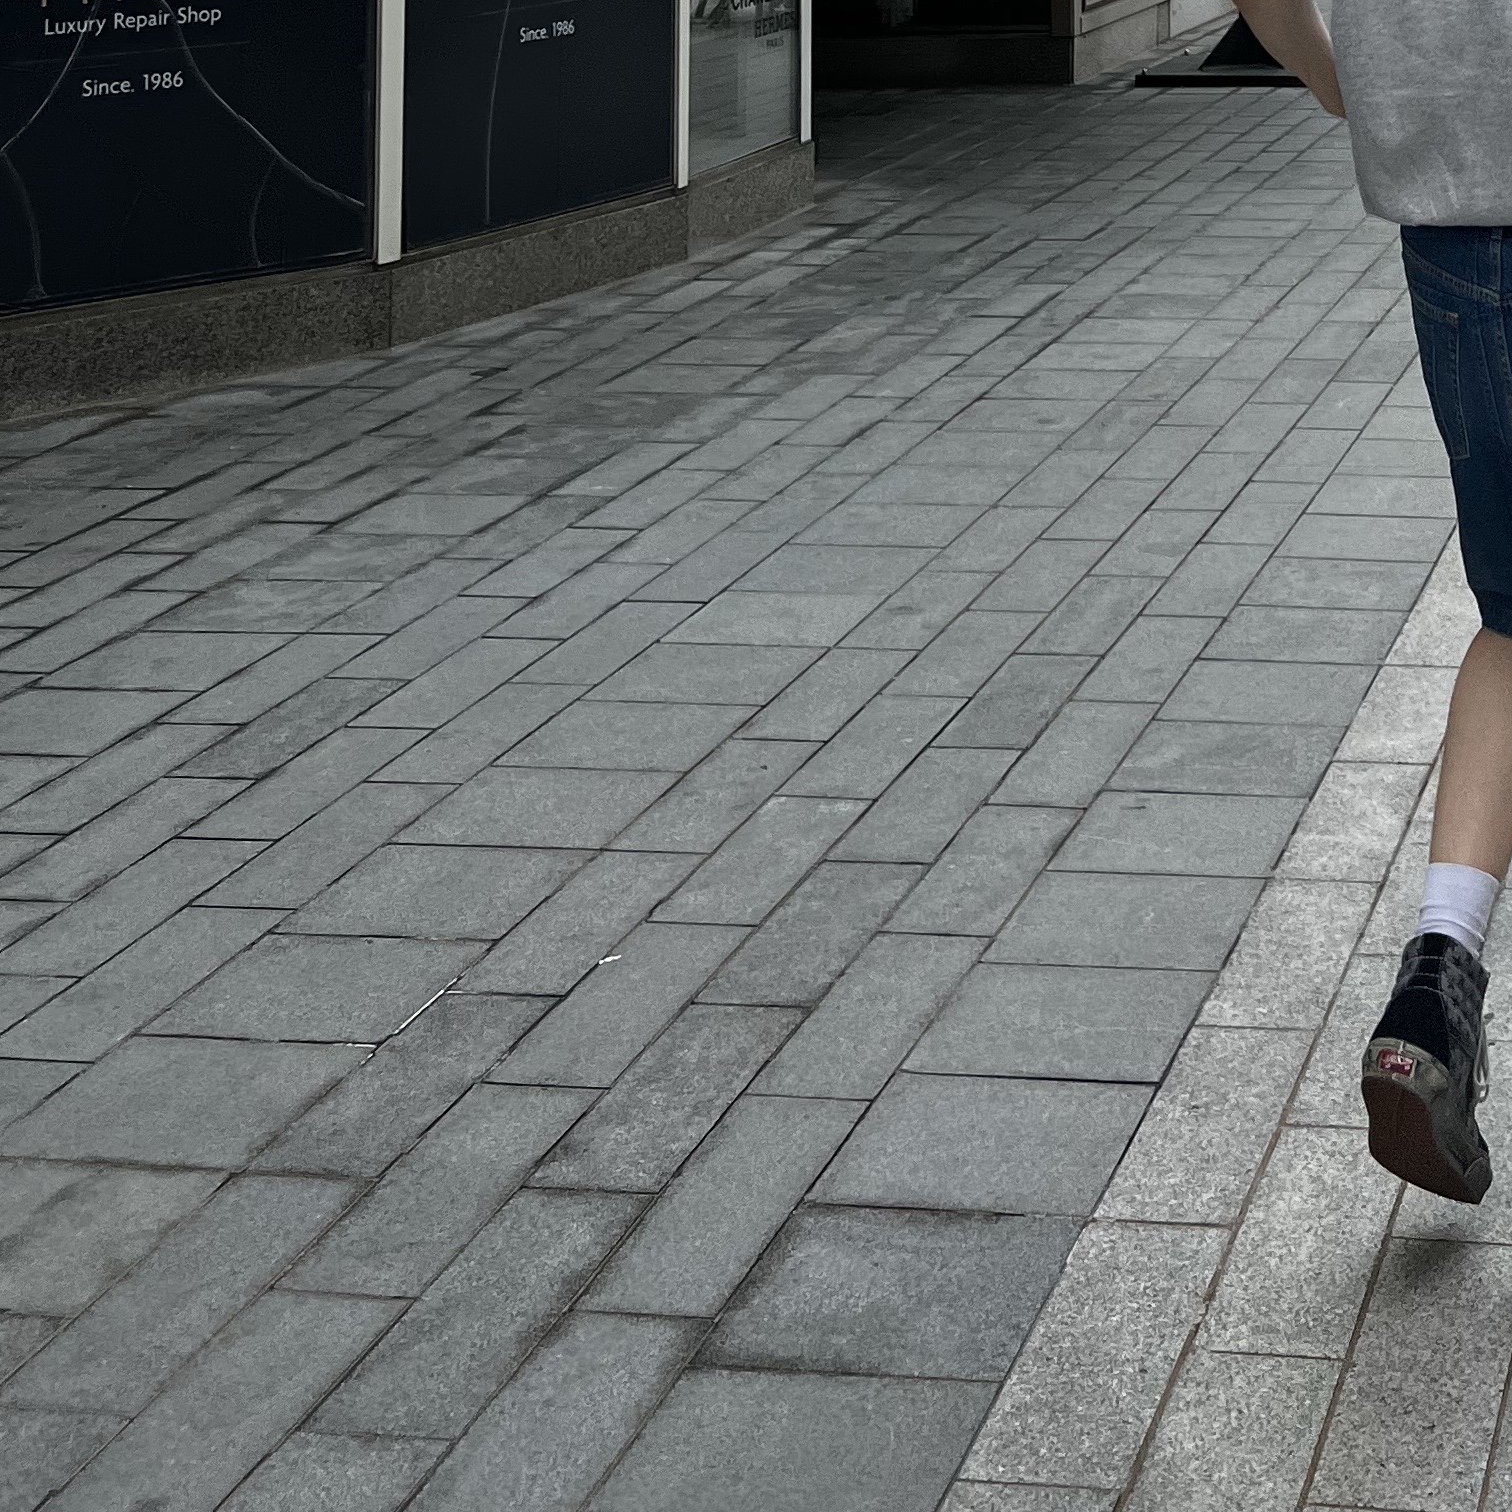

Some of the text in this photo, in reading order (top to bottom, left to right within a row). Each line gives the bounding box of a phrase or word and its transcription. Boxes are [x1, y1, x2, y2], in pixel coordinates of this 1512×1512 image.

[44, 5, 222, 38] Luxury Repair Shop
[519, 19, 576, 43] Since. 1986
[82, 71, 184, 97] Since. 1986
